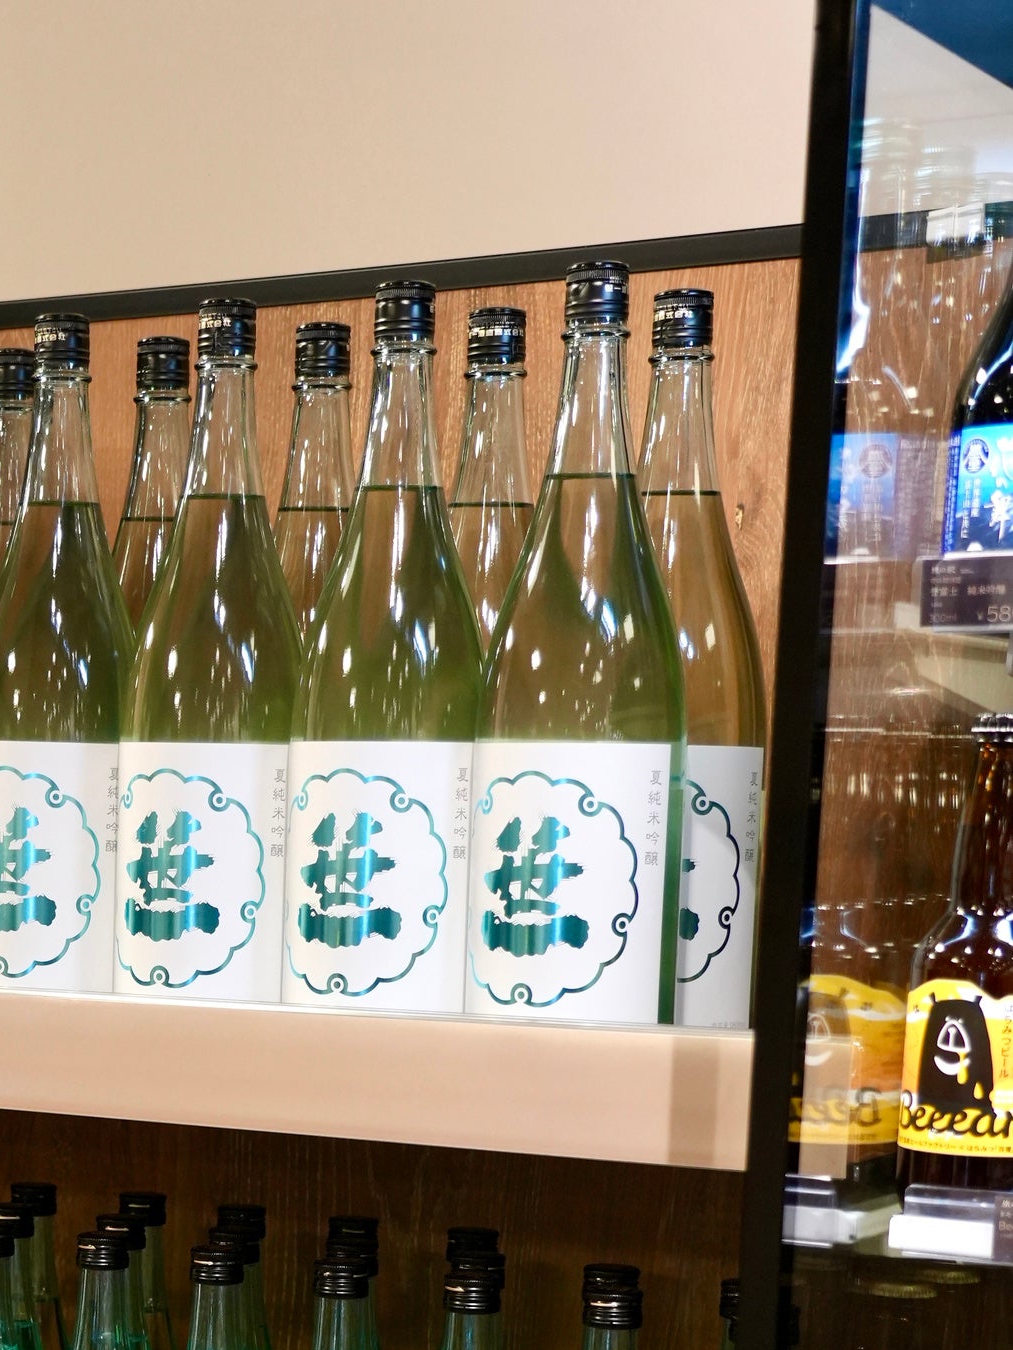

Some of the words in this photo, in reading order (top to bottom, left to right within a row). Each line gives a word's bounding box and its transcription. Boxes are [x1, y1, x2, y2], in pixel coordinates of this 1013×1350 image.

[270, 768, 286, 859] 夏純米吟醸
[453, 767, 469, 860] 夏純米吟醸
[644, 770, 662, 867] 夏純米吟醸
